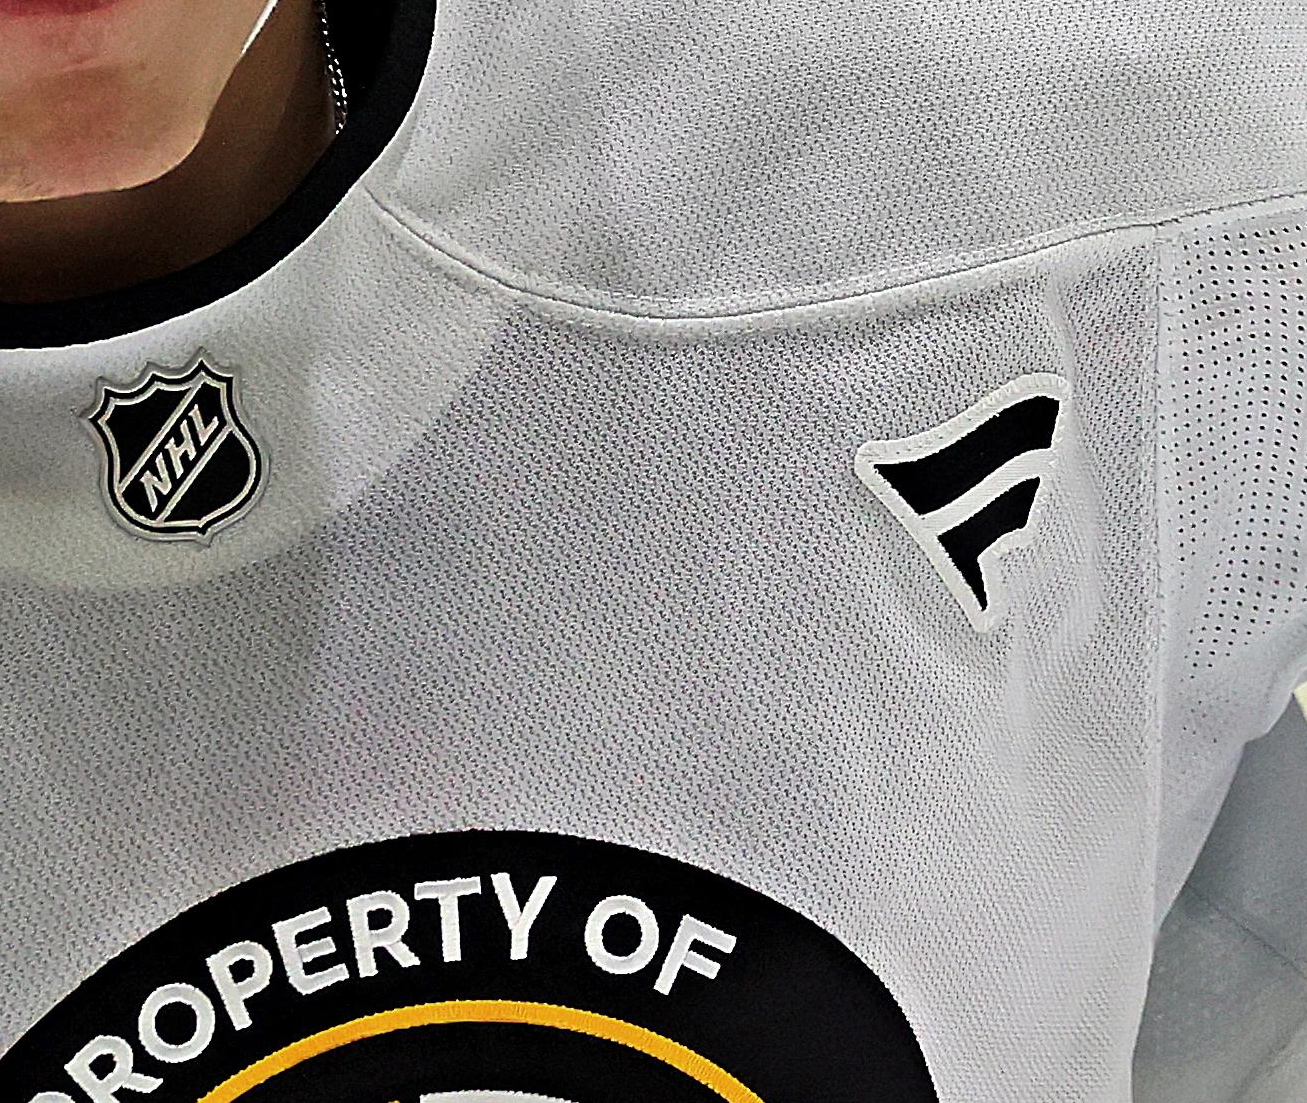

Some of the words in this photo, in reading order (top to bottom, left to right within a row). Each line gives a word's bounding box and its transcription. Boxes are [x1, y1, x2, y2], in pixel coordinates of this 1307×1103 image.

[140, 404, 219, 512] NHL
[28, 873, 558, 1103] ROPERTY
[584, 895, 737, 995] OF
